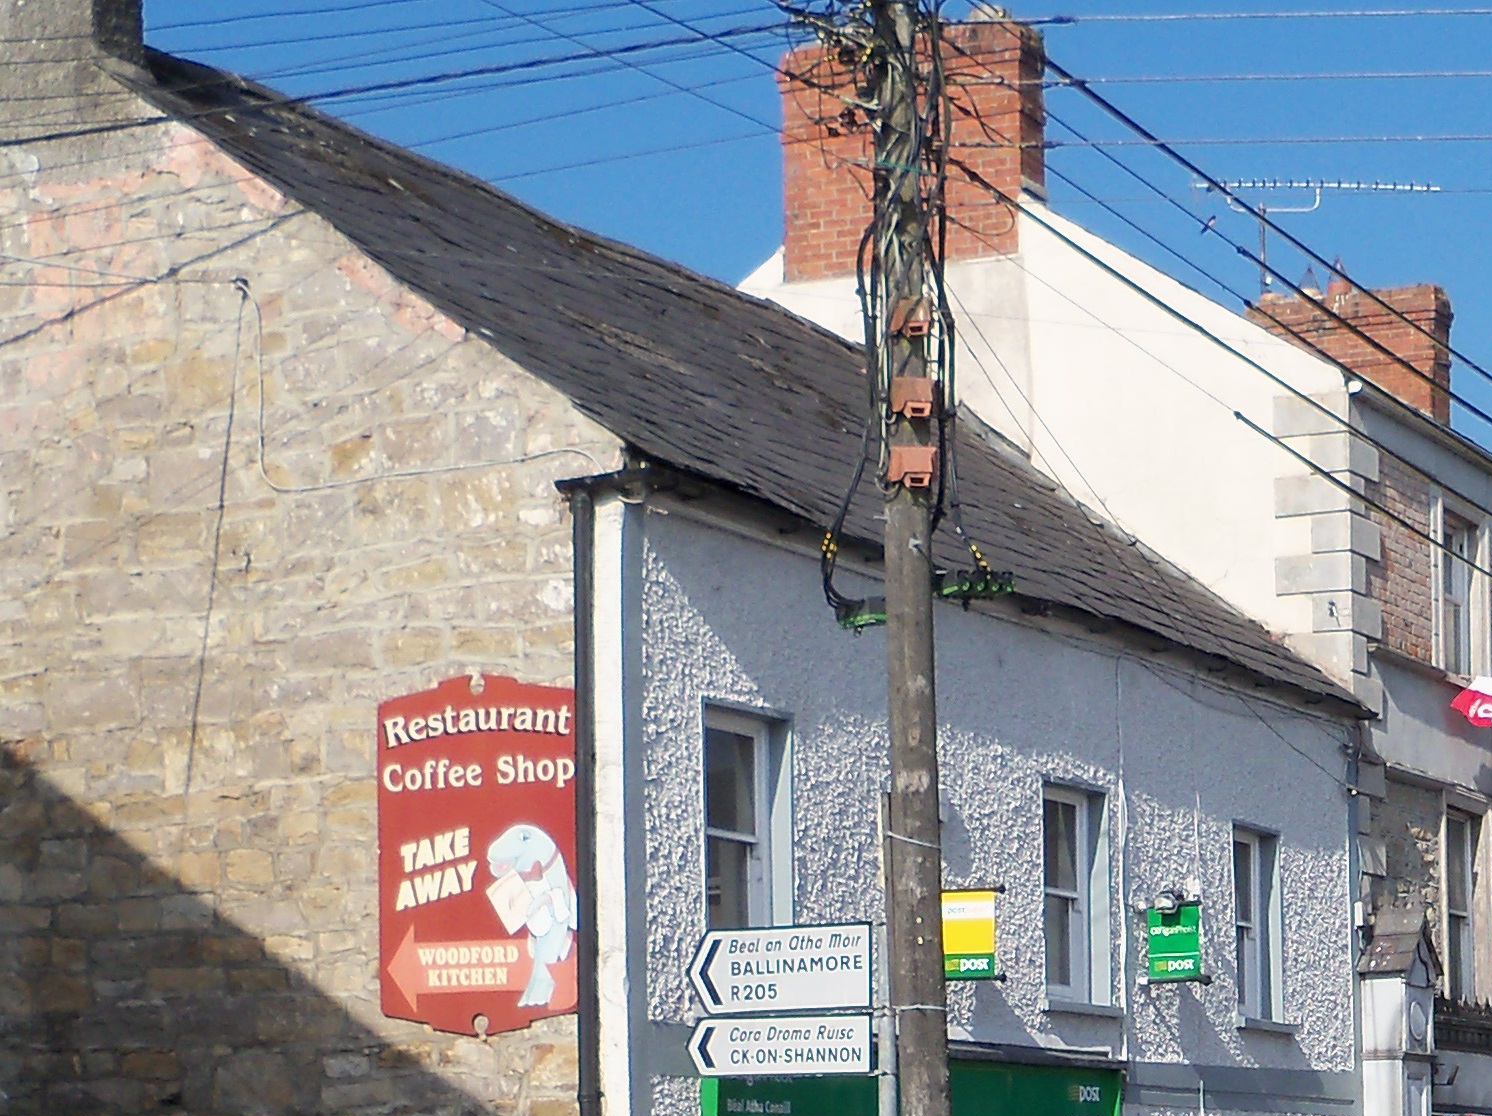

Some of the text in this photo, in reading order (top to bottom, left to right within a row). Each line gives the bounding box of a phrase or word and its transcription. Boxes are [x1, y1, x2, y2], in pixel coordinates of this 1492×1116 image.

[384, 705, 571, 749] Restaurant
[383, 754, 575, 792] Coffee Shop
[400, 828, 470, 873] TAKE
[396, 861, 477, 911] AWAY
[417, 945, 519, 965] WOODFORD
[765, 939, 782, 952] an
[731, 955, 863, 977] BALLINAMORE
[428, 967, 508, 987] KITCHEN
[731, 984, 778, 1001] R205
[729, 1027, 761, 1042] Cora
[766, 1026, 811, 1041] Droma
[730, 1047, 862, 1065] CK-ON-SHANNON
